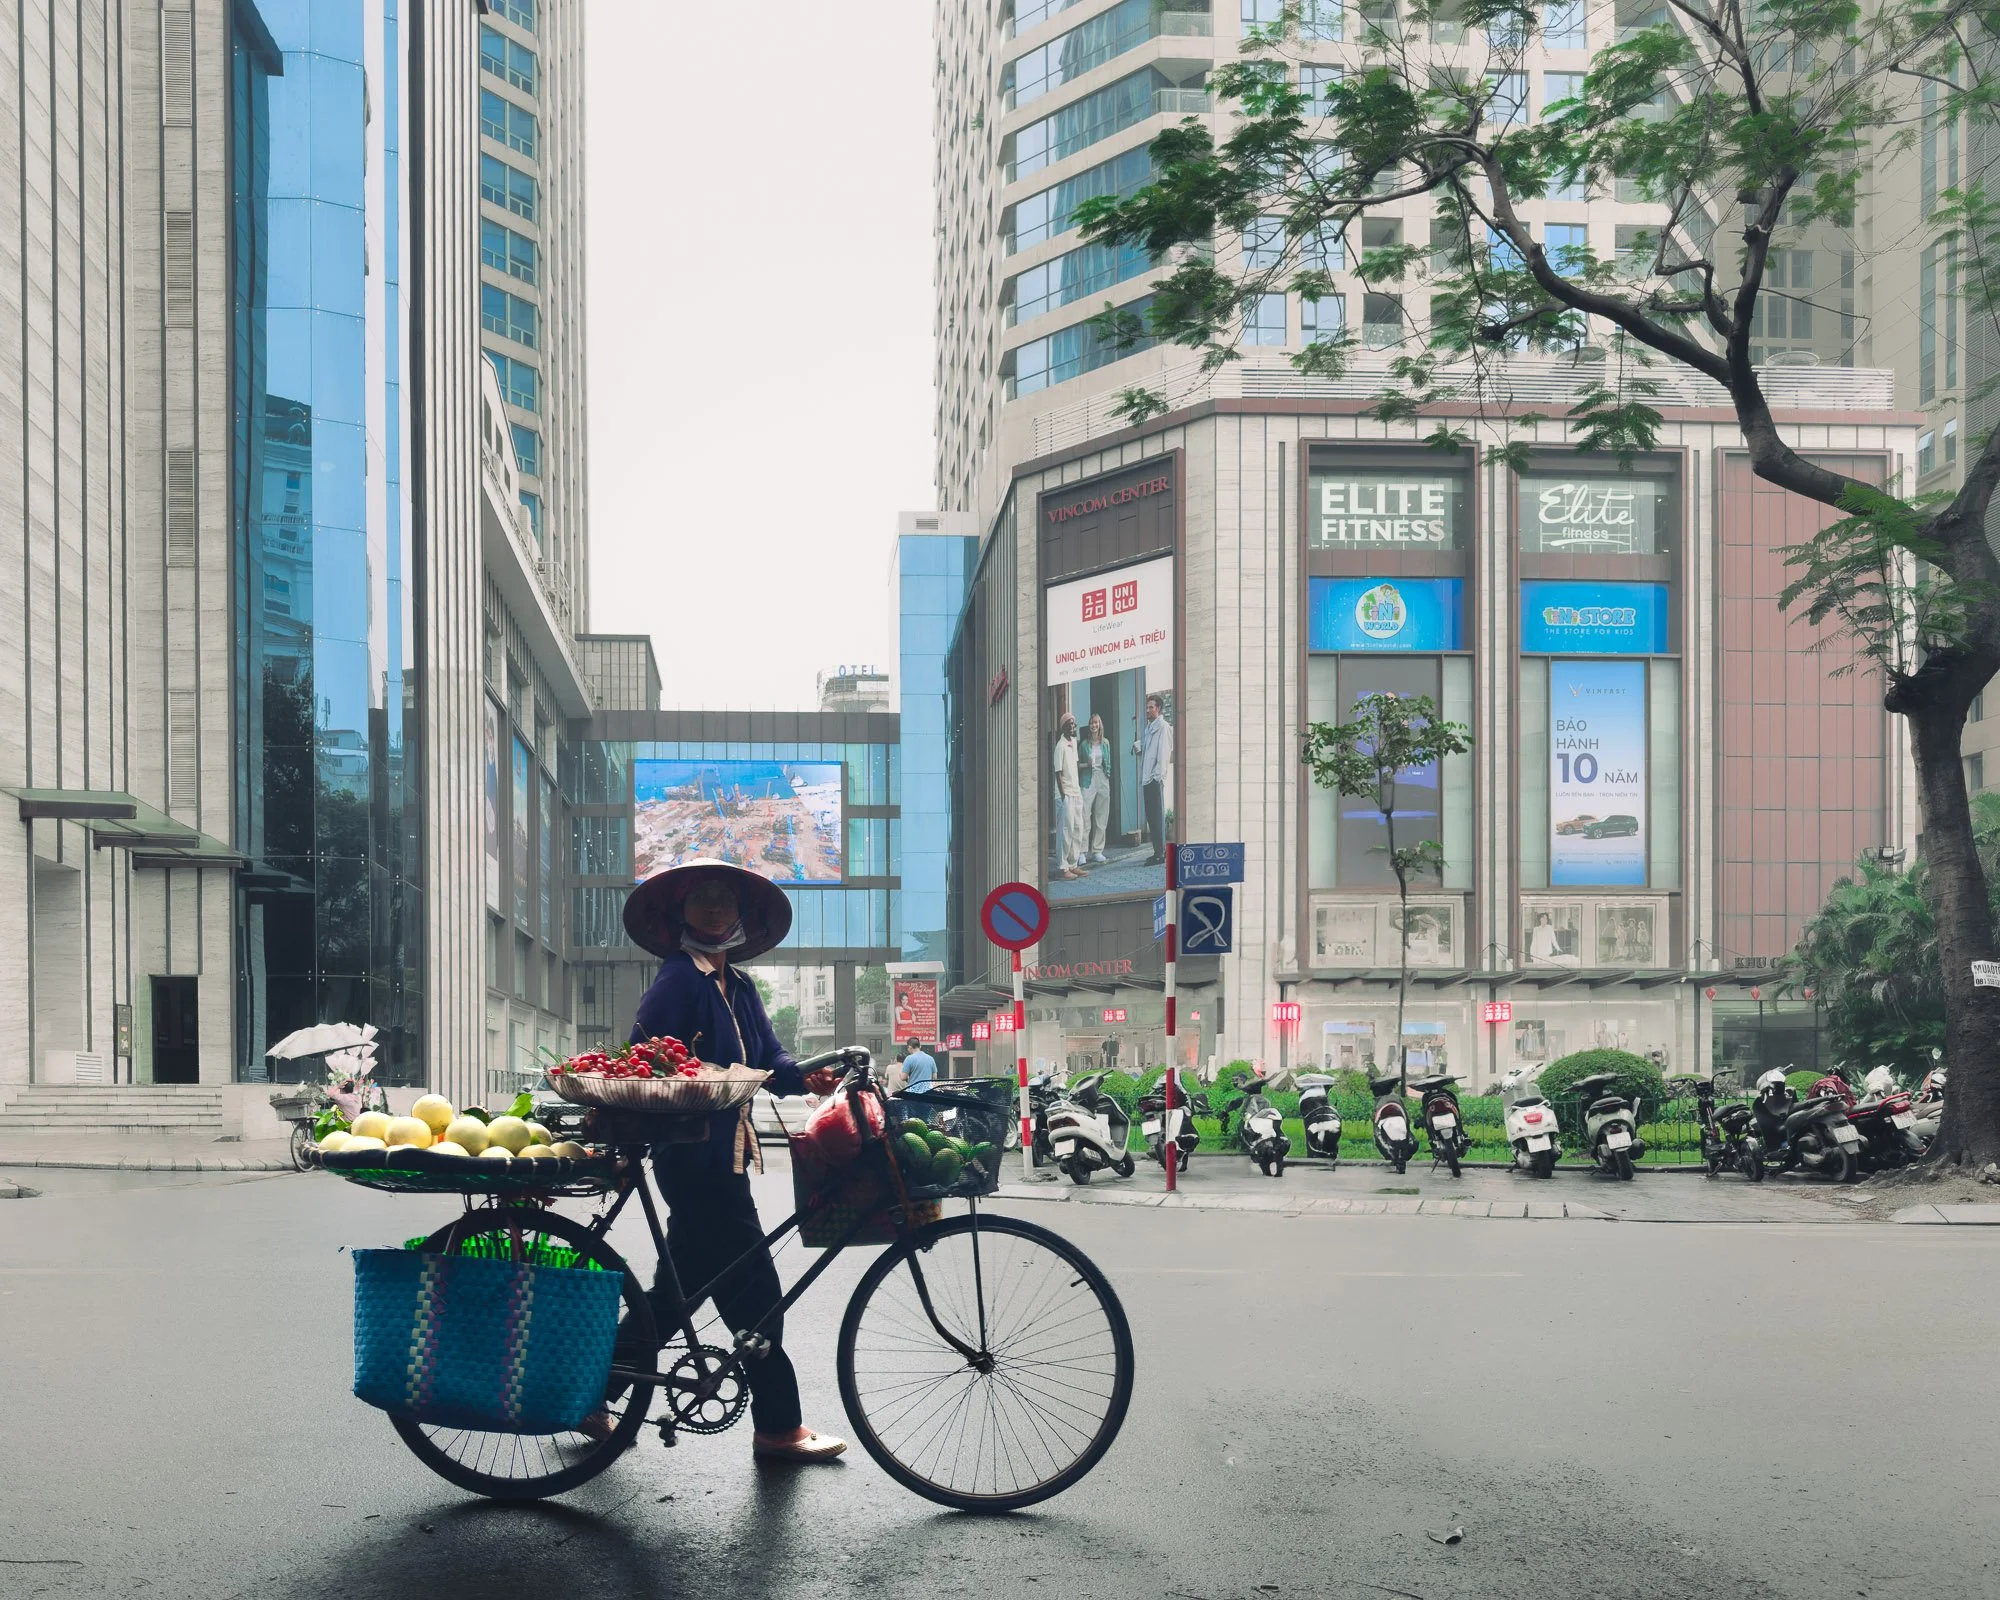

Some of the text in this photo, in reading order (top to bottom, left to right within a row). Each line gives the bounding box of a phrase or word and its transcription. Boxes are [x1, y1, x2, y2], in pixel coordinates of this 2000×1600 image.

[1048, 476, 1170, 524] VINCOM CENTER
[1322, 483, 1444, 515] ELITE
[1539, 484, 1635, 525] Elite
[1322, 519, 1444, 541] FITNESS
[1562, 526, 1608, 539] fitness
[1364, 621, 1399, 630] WORLD
[1056, 649, 1086, 664] UNIQLO
[1089, 641, 1120, 657] VINCOM
[1123, 635, 1136, 649] BÀ
[1140, 629, 1166, 645] TRIỆU
[1556, 716, 1587, 732] BẢO
[1556, 734, 1599, 749] HÀNH
[1556, 753, 1638, 784] 10 NĂM
[1022, 959, 1135, 980] INCOM CENTER
